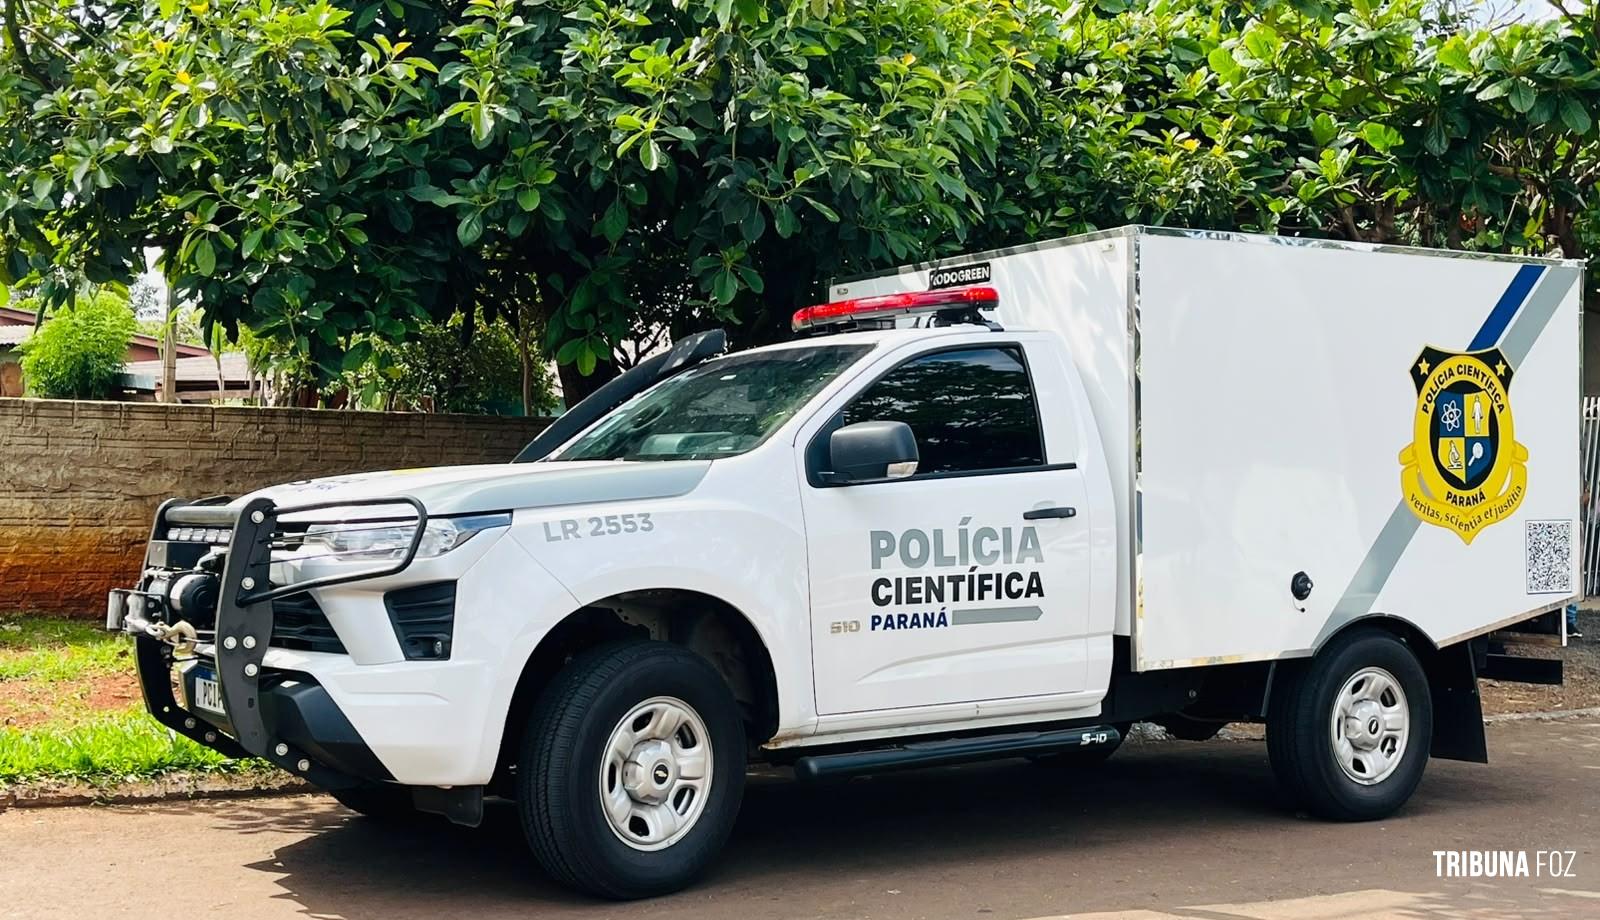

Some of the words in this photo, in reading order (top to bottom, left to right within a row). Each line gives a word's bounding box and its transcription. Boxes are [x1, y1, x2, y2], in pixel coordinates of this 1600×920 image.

[1422, 368, 1455, 414] POLÍCIA
[1456, 364, 1505, 414] CIENTÍFICA
[1410, 493, 1443, 522] veritas,
[1445, 512, 1482, 532] scientia
[1484, 507, 1493, 520] et
[1493, 485, 1522, 519] justitia
[1445, 488, 1486, 508] PARANÁ
[543, 519, 582, 542] LR
[587, 512, 655, 537] 2553
[870, 516, 1045, 570] POLÍCIA
[871, 566, 1045, 607] CIENTÍFICA
[871, 607, 948, 631] PARANÁ
[1080, 733, 1107, 746] S-10
